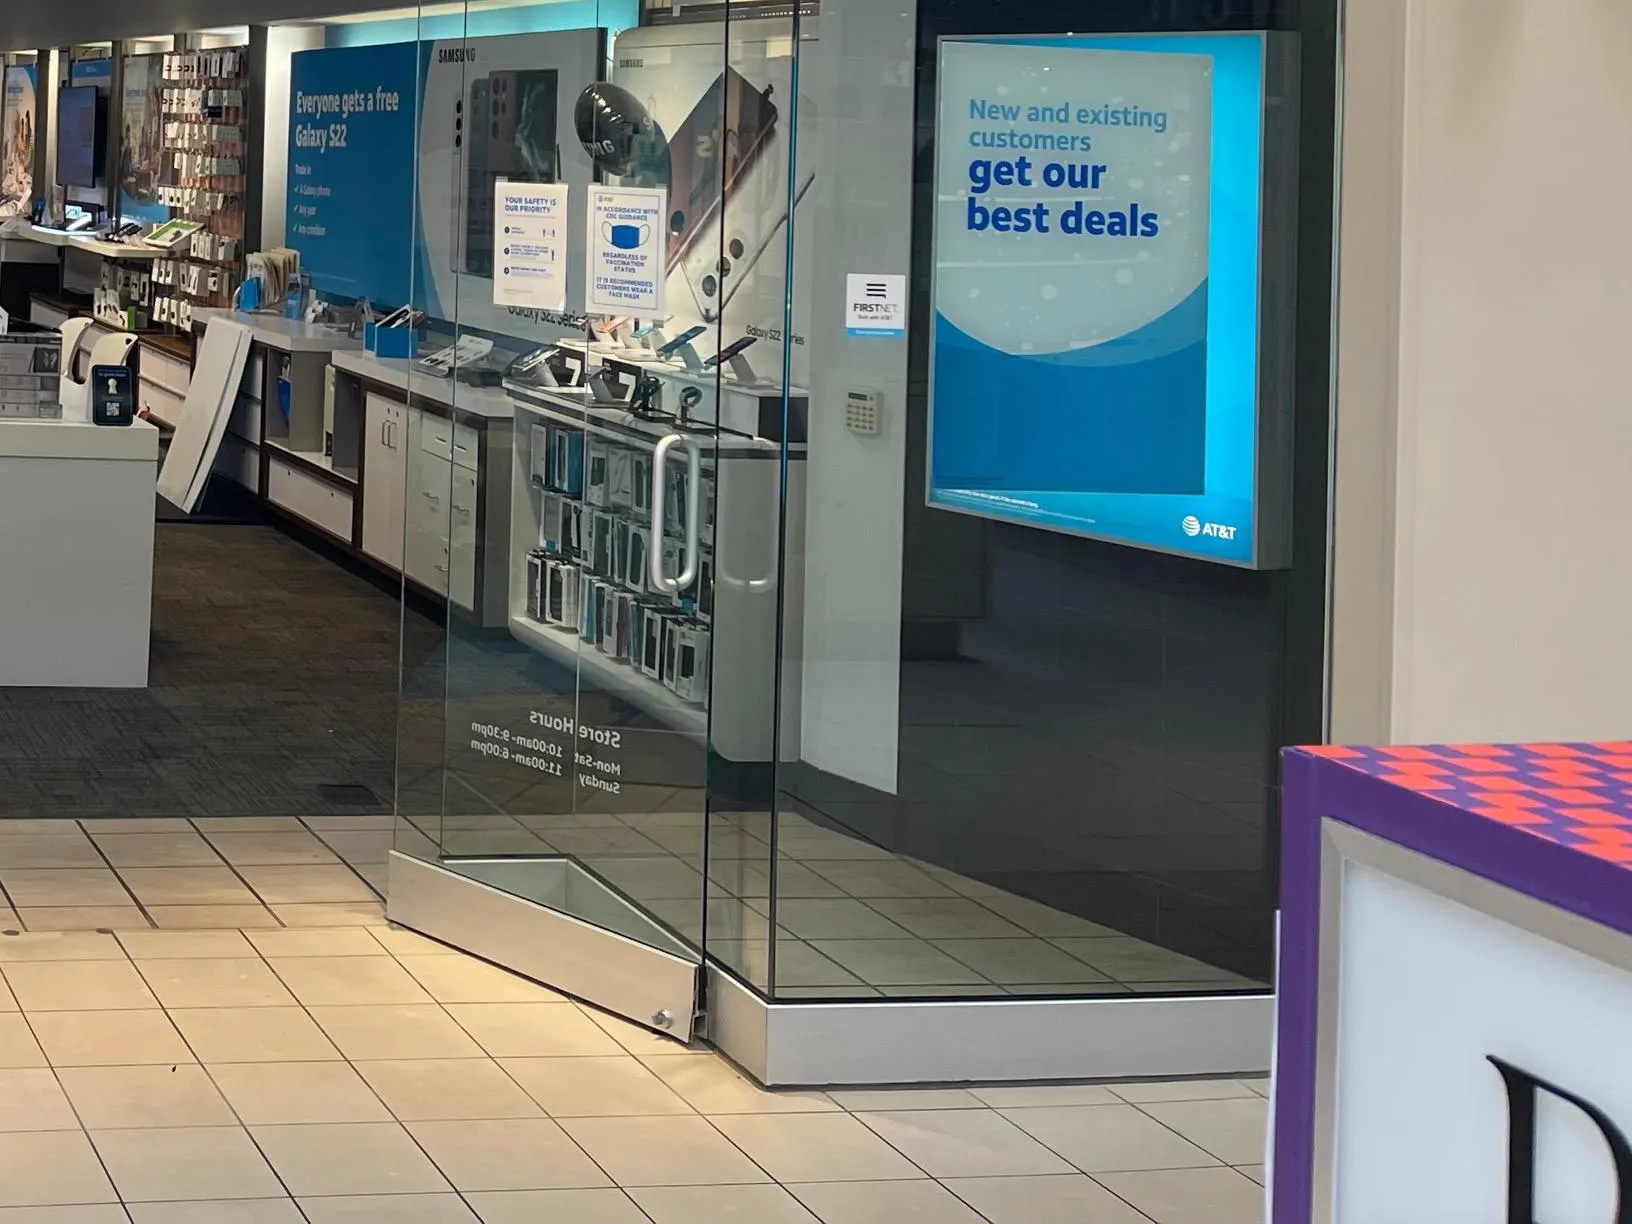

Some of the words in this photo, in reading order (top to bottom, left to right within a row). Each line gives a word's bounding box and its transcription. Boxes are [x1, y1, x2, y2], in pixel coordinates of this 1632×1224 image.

[439, 47, 476, 63] SAMSUNG
[296, 91, 341, 120] Everyone
[342, 90, 364, 118] gets
[367, 93, 374, 111] a
[376, 85, 399, 112] free
[969, 99, 1021, 120] New
[1027, 102, 1069, 123] and
[1076, 104, 1167, 133] existing
[295, 123, 327, 154] Galaxy
[329, 123, 347, 147] S22
[969, 129, 1092, 152] customers
[969, 156, 1032, 194] get
[1042, 162, 1107, 189] our
[520, 205, 550, 213] PRIORITY
[603, 206, 641, 214] ACCORDANCE
[967, 196, 1050, 233] best
[1060, 201, 1159, 237] deals
[603, 252, 638, 260] REGARDLESS
[605, 259, 644, 267] VACCINATION
[596, 283, 630, 292] CUSTOMERS
[609, 278, 653, 287] RECOMMENDED
[746, 325, 768, 341] Galaxy
[1202, 522, 1236, 541] AT&T
